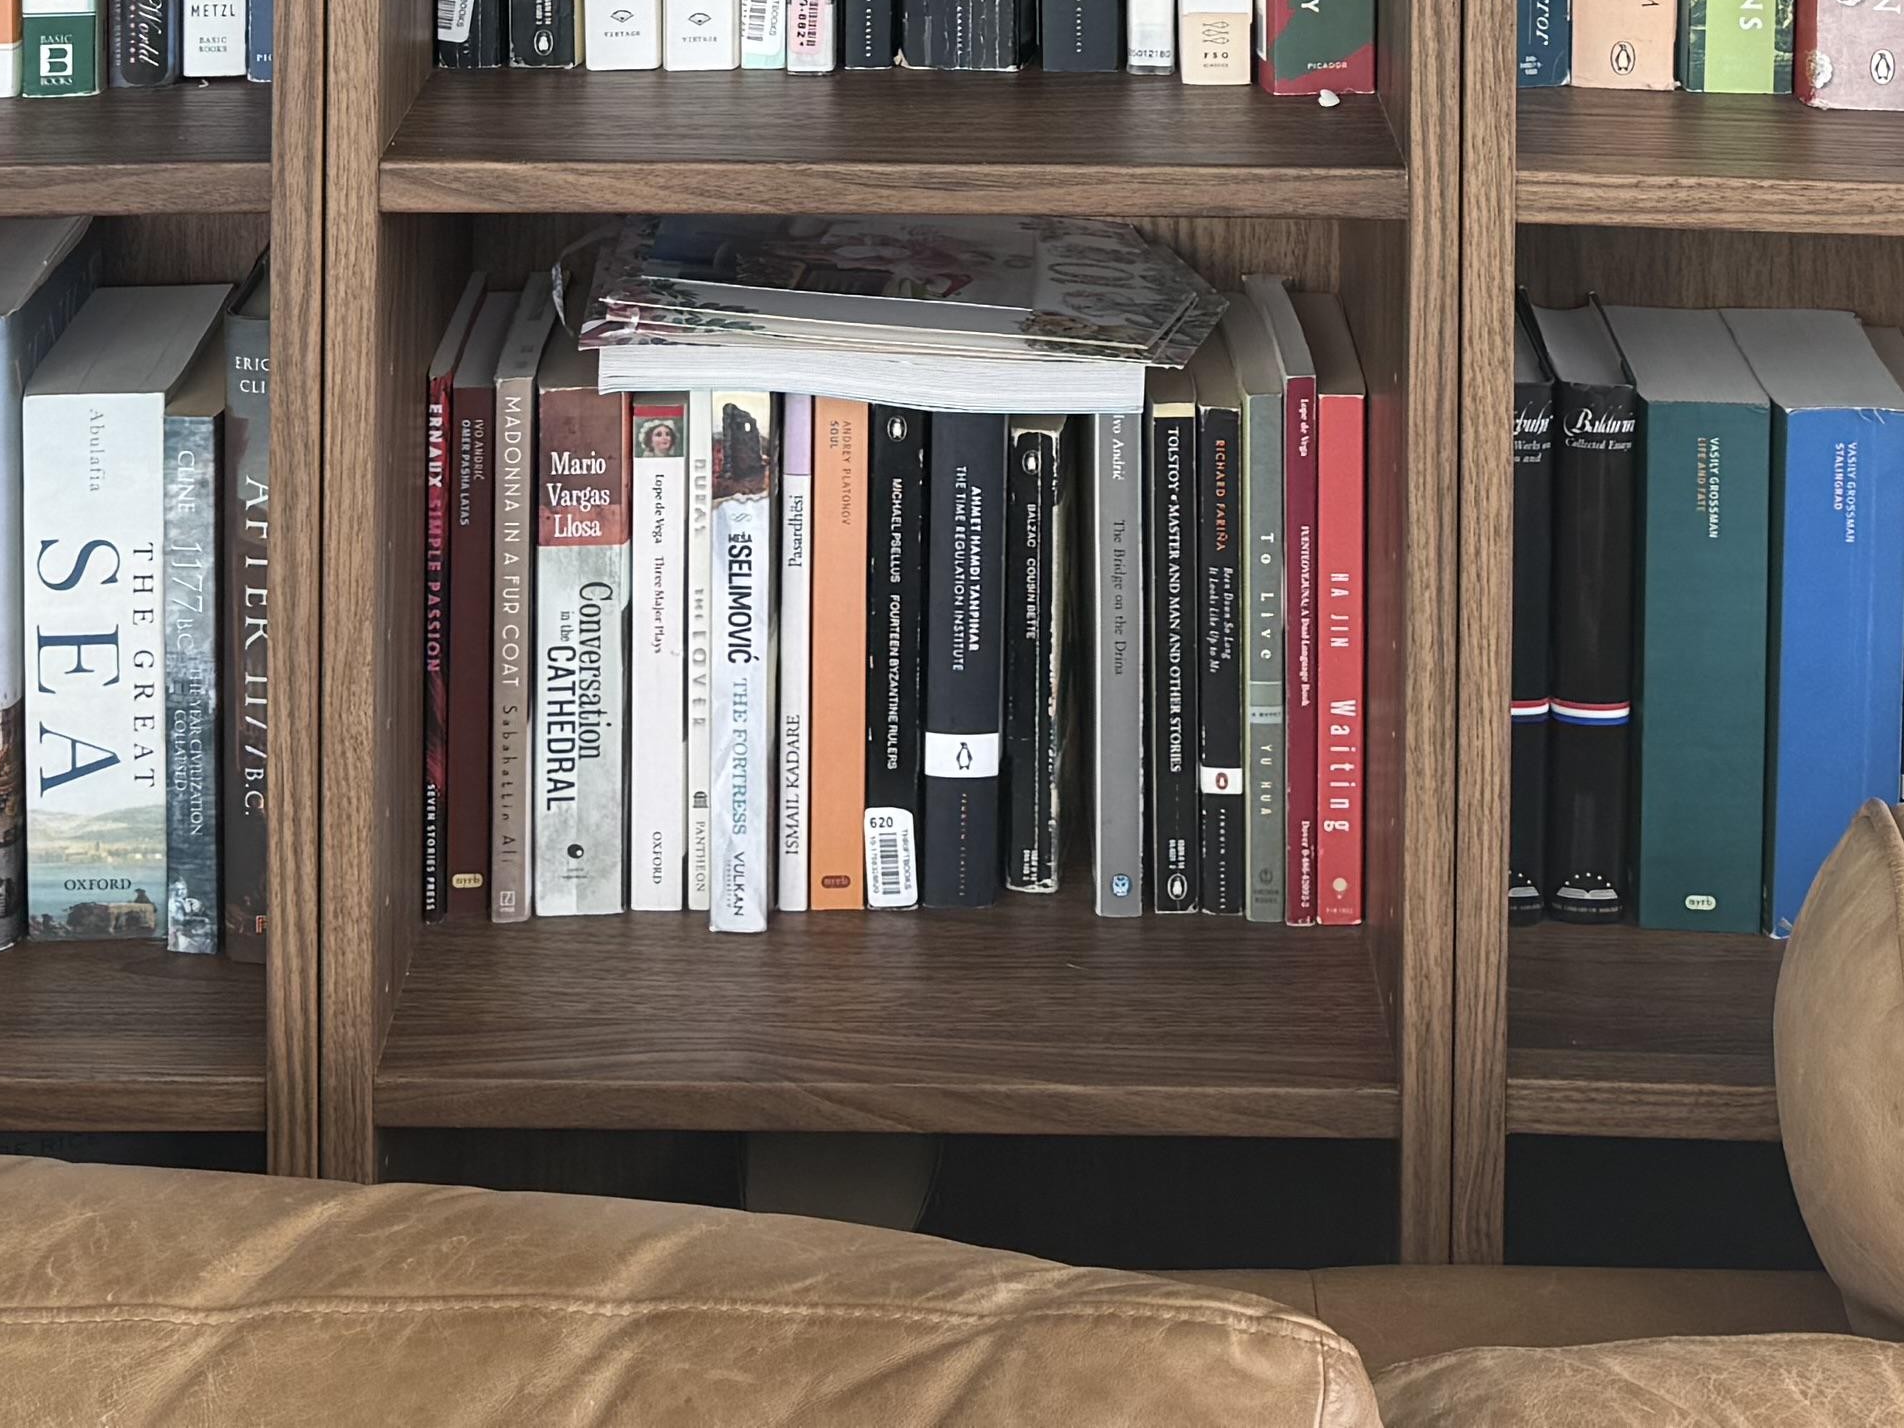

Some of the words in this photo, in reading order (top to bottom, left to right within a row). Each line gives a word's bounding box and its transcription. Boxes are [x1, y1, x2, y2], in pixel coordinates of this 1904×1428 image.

[190, 3, 235, 18] METZL
[550, 451, 606, 475] Mario
[547, 484, 611, 511] Vargas
[552, 514, 602, 540] Llosa
[34, 536, 122, 798] SEA
[543, 644, 577, 813] CATHEDRAL
[1322, 700, 1356, 834] Waiting
[869, 816, 894, 830] 620
[63, 877, 133, 893] OXFORD
